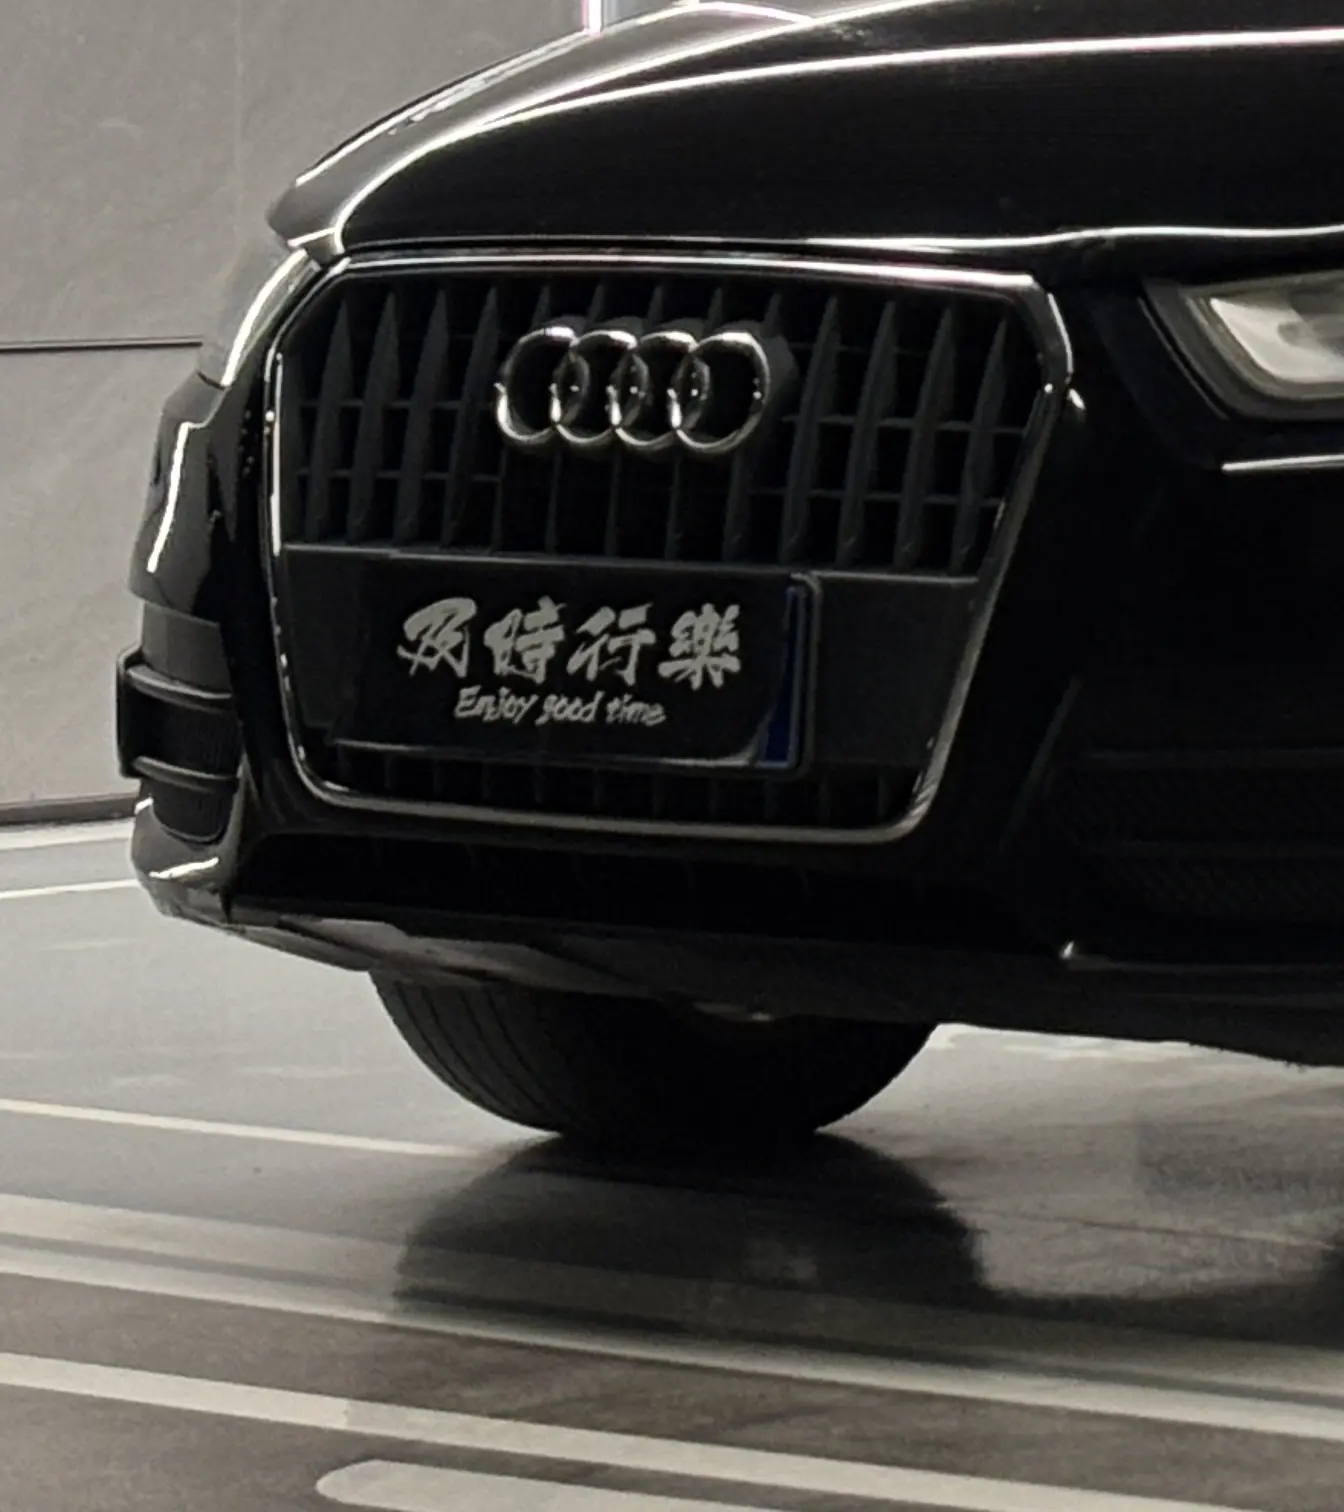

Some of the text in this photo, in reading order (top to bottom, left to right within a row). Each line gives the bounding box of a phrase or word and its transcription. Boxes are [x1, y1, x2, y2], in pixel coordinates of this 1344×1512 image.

[397, 596, 742, 690] 及時行樂
[453, 685, 668, 727] Enjoy good time
